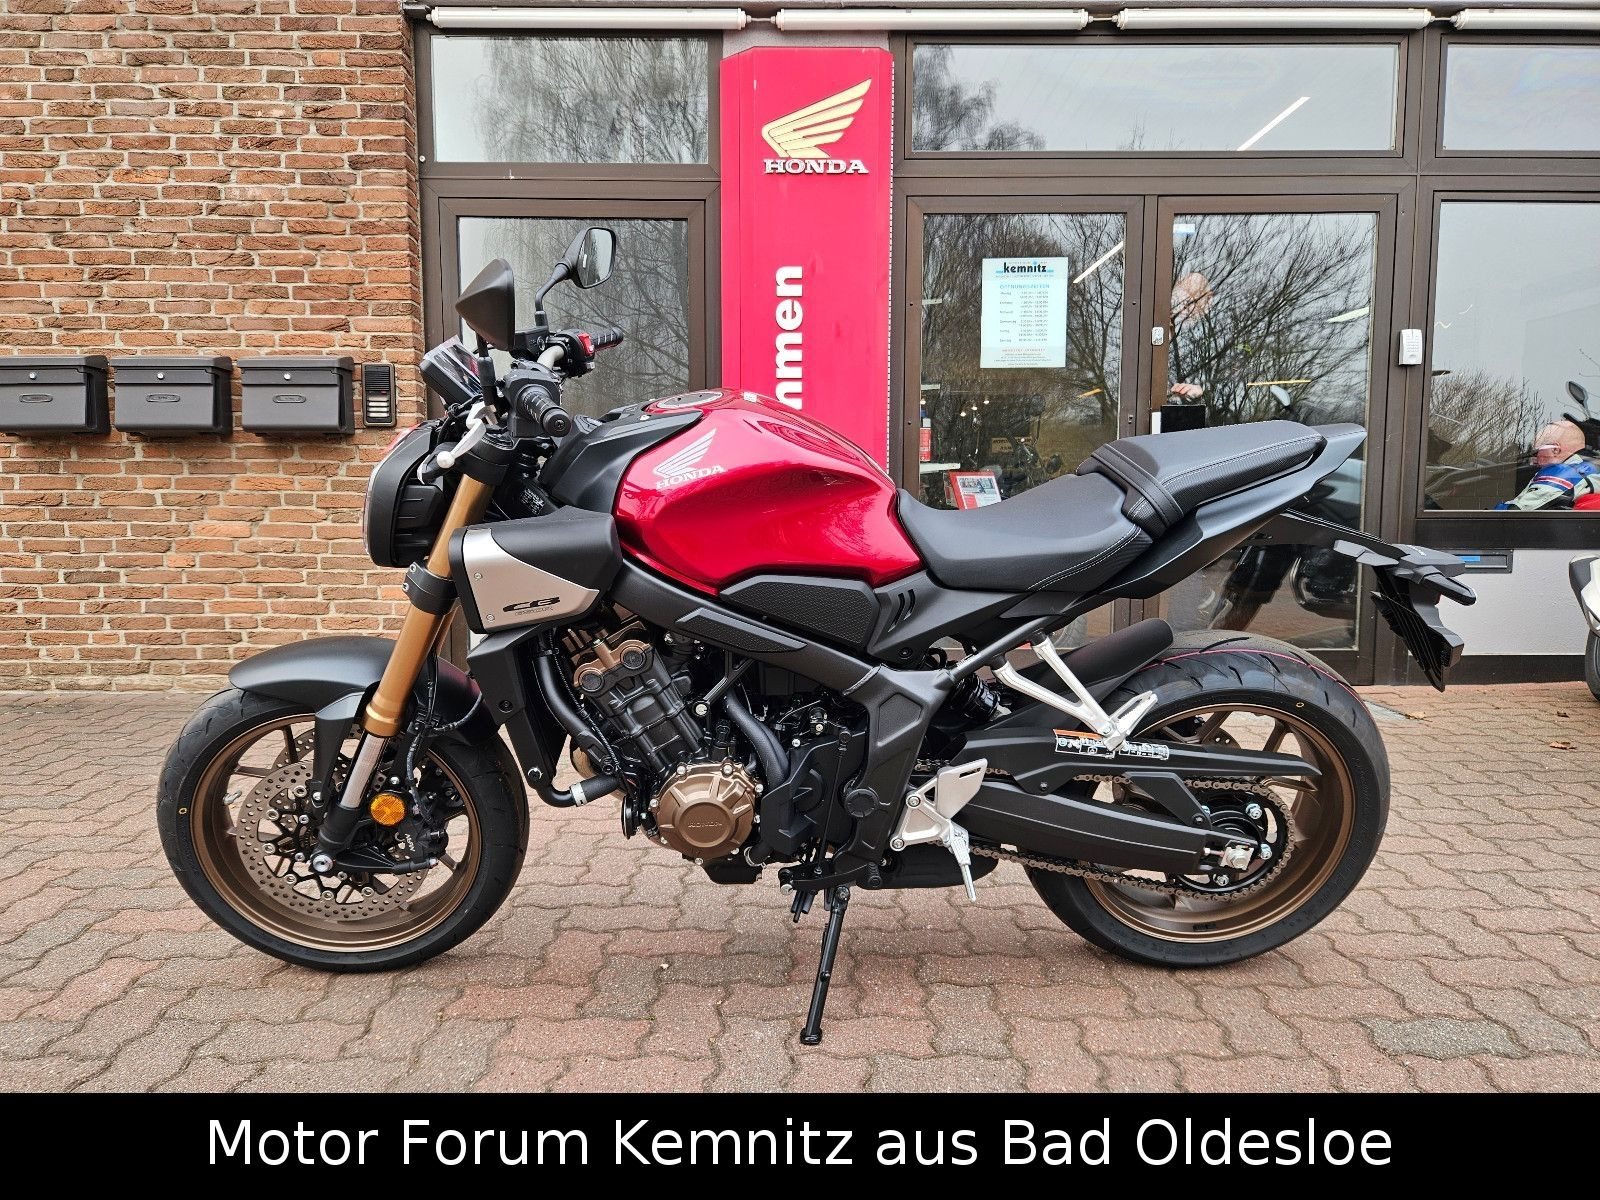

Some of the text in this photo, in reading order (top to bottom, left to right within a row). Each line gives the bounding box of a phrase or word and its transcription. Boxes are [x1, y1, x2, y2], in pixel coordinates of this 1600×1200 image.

[763, 159, 869, 175] HONDA
[1003, 261, 1047, 273] kemnitz
[656, 465, 727, 490] HONDA
